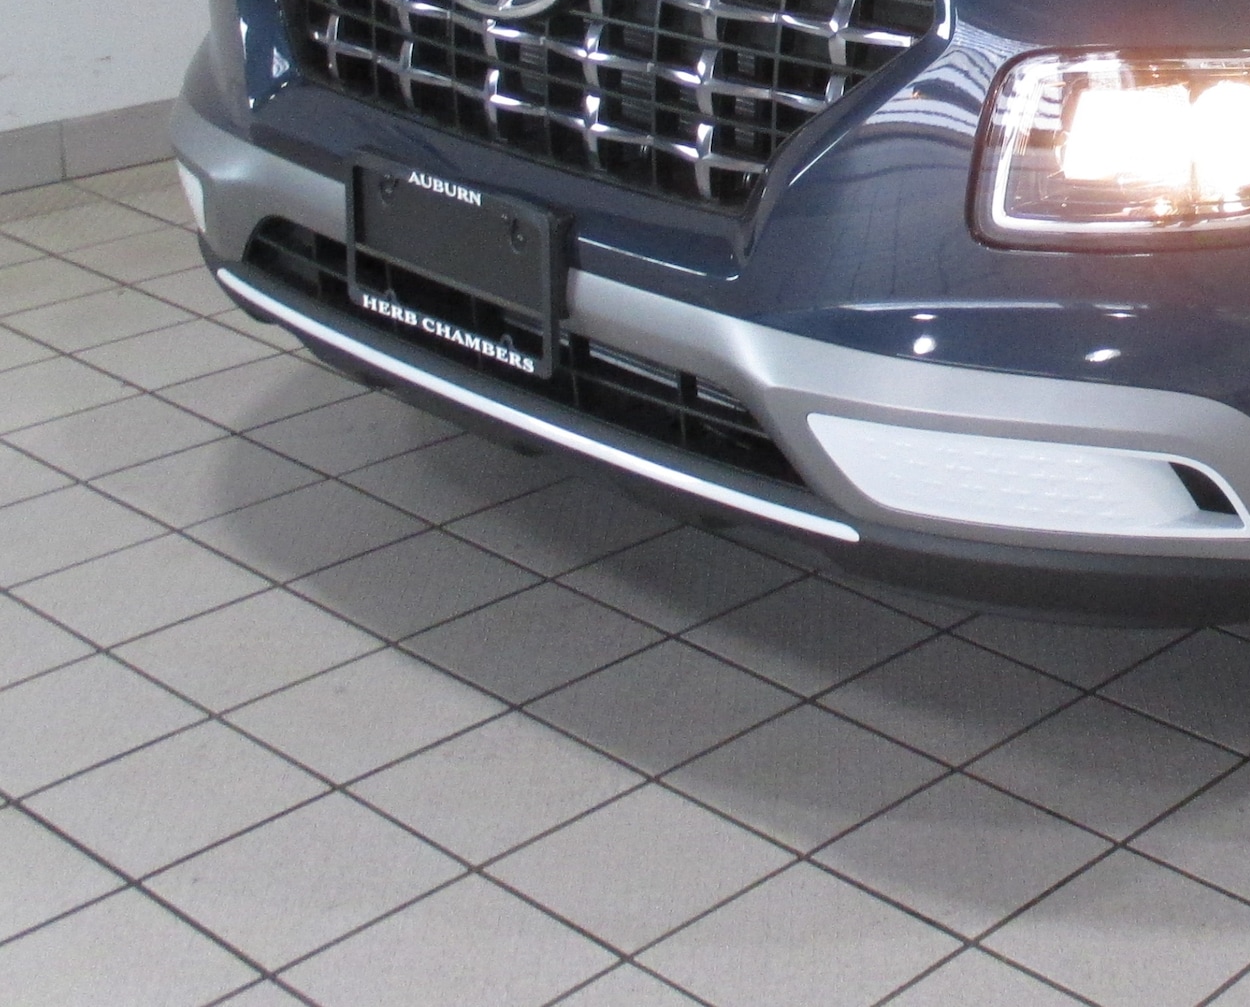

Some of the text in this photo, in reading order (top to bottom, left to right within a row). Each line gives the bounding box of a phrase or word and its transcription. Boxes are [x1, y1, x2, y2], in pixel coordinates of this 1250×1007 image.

[408, 171, 482, 207] AUBURN
[362, 294, 535, 373] HERB CHAMBERS
